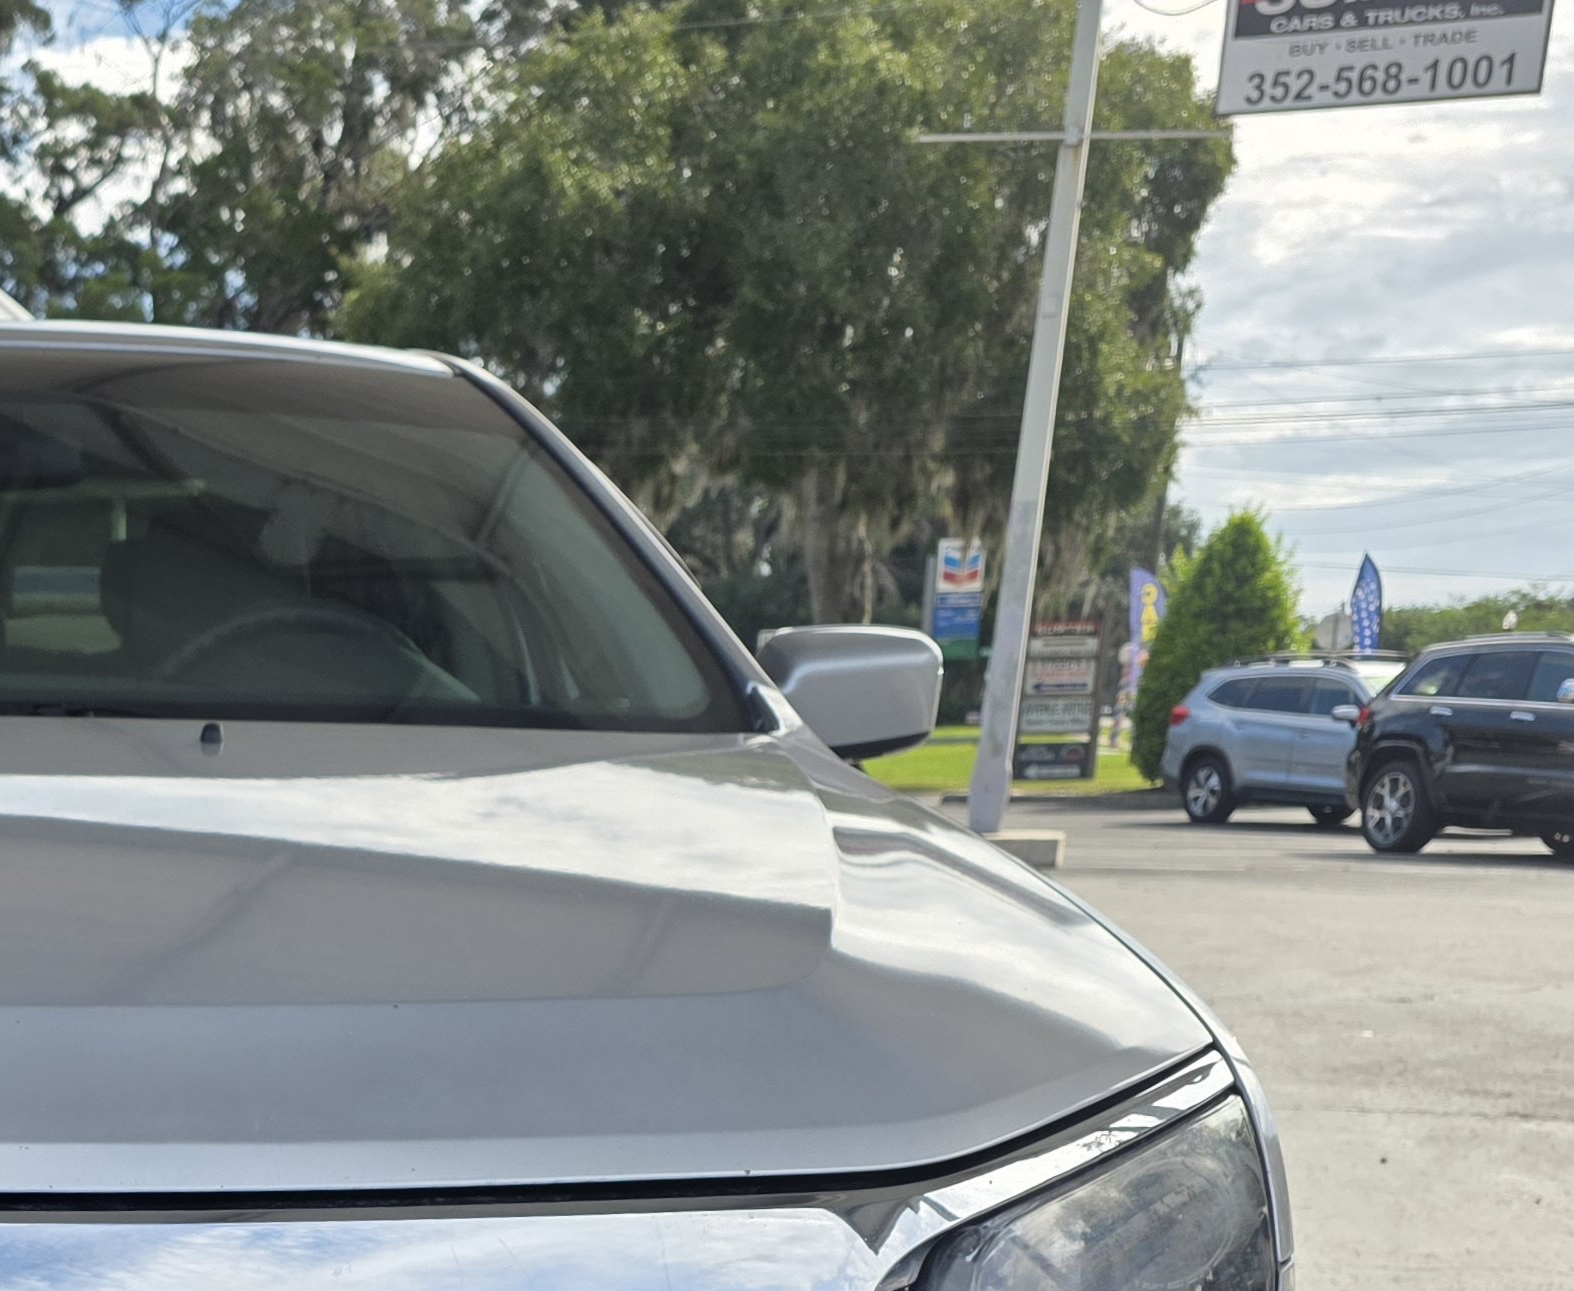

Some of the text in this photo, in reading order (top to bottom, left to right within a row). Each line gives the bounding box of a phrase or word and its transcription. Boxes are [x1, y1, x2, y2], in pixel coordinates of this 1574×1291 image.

[1270, 14, 1334, 34] CARS
[1339, 9, 1359, 28] &
[1288, 29, 1479, 58] BUY SELL TRADE
[1244, 52, 1518, 106] 352-568-1001
